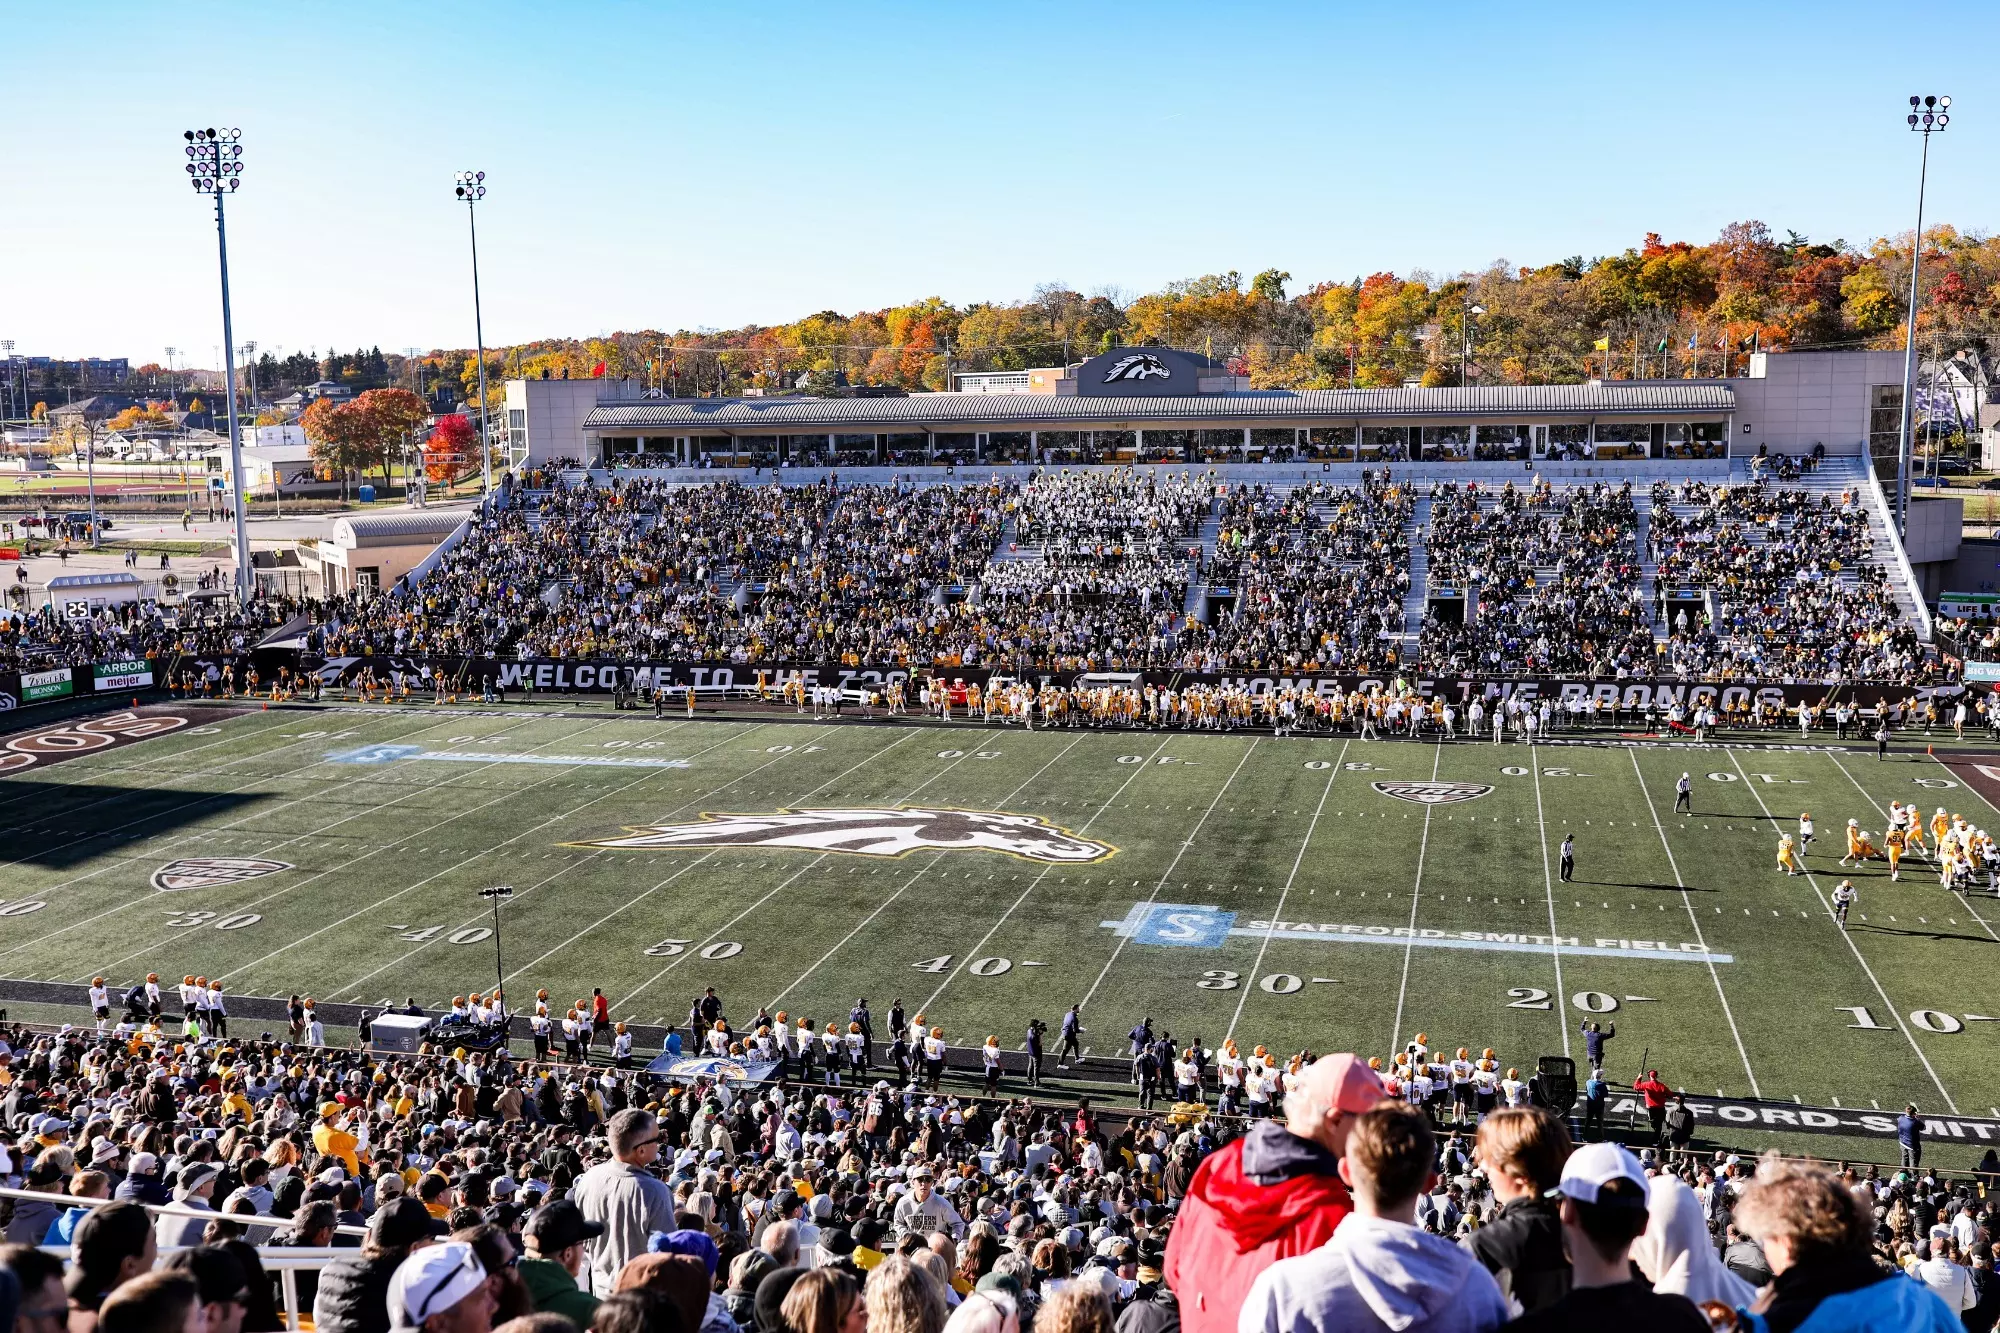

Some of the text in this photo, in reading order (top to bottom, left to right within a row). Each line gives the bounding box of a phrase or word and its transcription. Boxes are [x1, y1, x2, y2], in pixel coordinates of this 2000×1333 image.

[68, 603, 87, 617] 25
[1957, 605, 1978, 613] LIFE
[102, 661, 146, 674] ARBOR
[1967, 667, 1985, 676] BIG
[28, 672, 66, 687] ZEIGLER
[107, 675, 140, 688] meijer
[690, 667, 734, 689] TO
[30, 684, 61, 695] BRONSON
[1559, 684, 1784, 712] BRONCOS
[1892, 835, 1902, 844] 93
[166, 911, 263, 930] 30
[1156, 912, 1215, 941] S
[402, 925, 493, 945] 40
[1248, 919, 1711, 953] STAFFORD-SMITH FIELD
[643, 938, 743, 960] 50
[911, 954, 1013, 976] 40
[1196, 969, 1304, 995] 30
[1506, 987, 1619, 1013] 20
[1834, 1006, 1962, 1034] 10
[869, 1102, 884, 1117] 86
